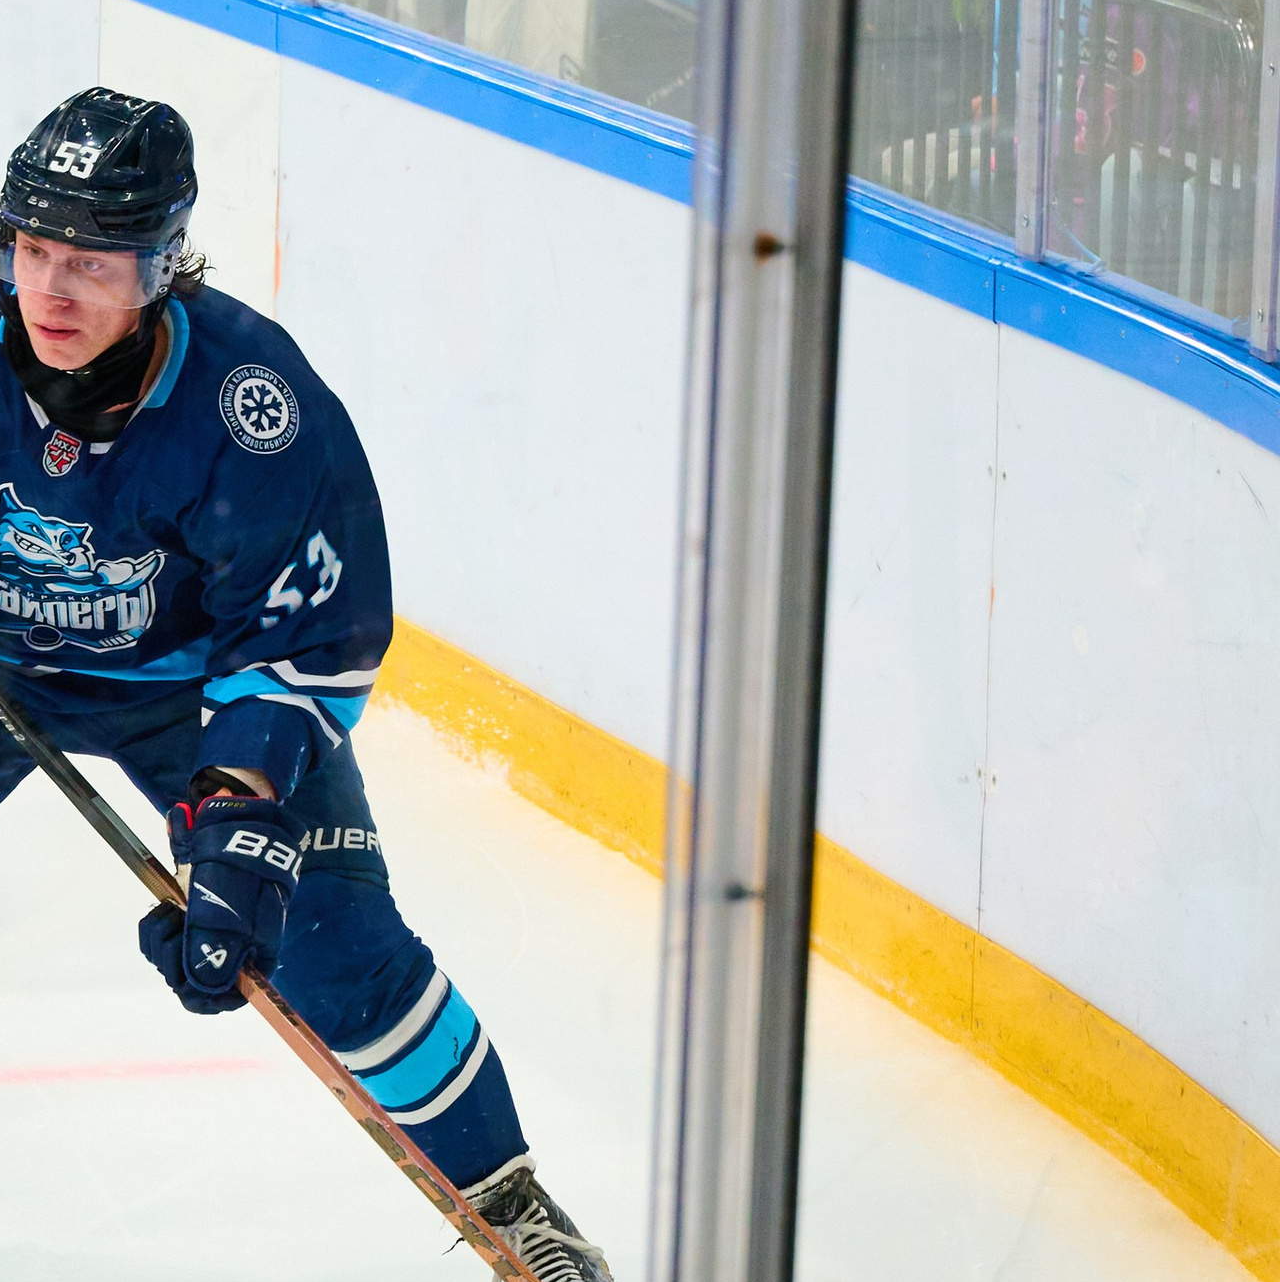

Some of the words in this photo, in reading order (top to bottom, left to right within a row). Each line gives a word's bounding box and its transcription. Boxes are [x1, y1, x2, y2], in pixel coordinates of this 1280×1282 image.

[48, 140, 101, 180] 53
[231, 368, 250, 385] КЛУБ
[250, 368, 279, 385] СИБИРЬ
[260, 529, 343, 630] 53
